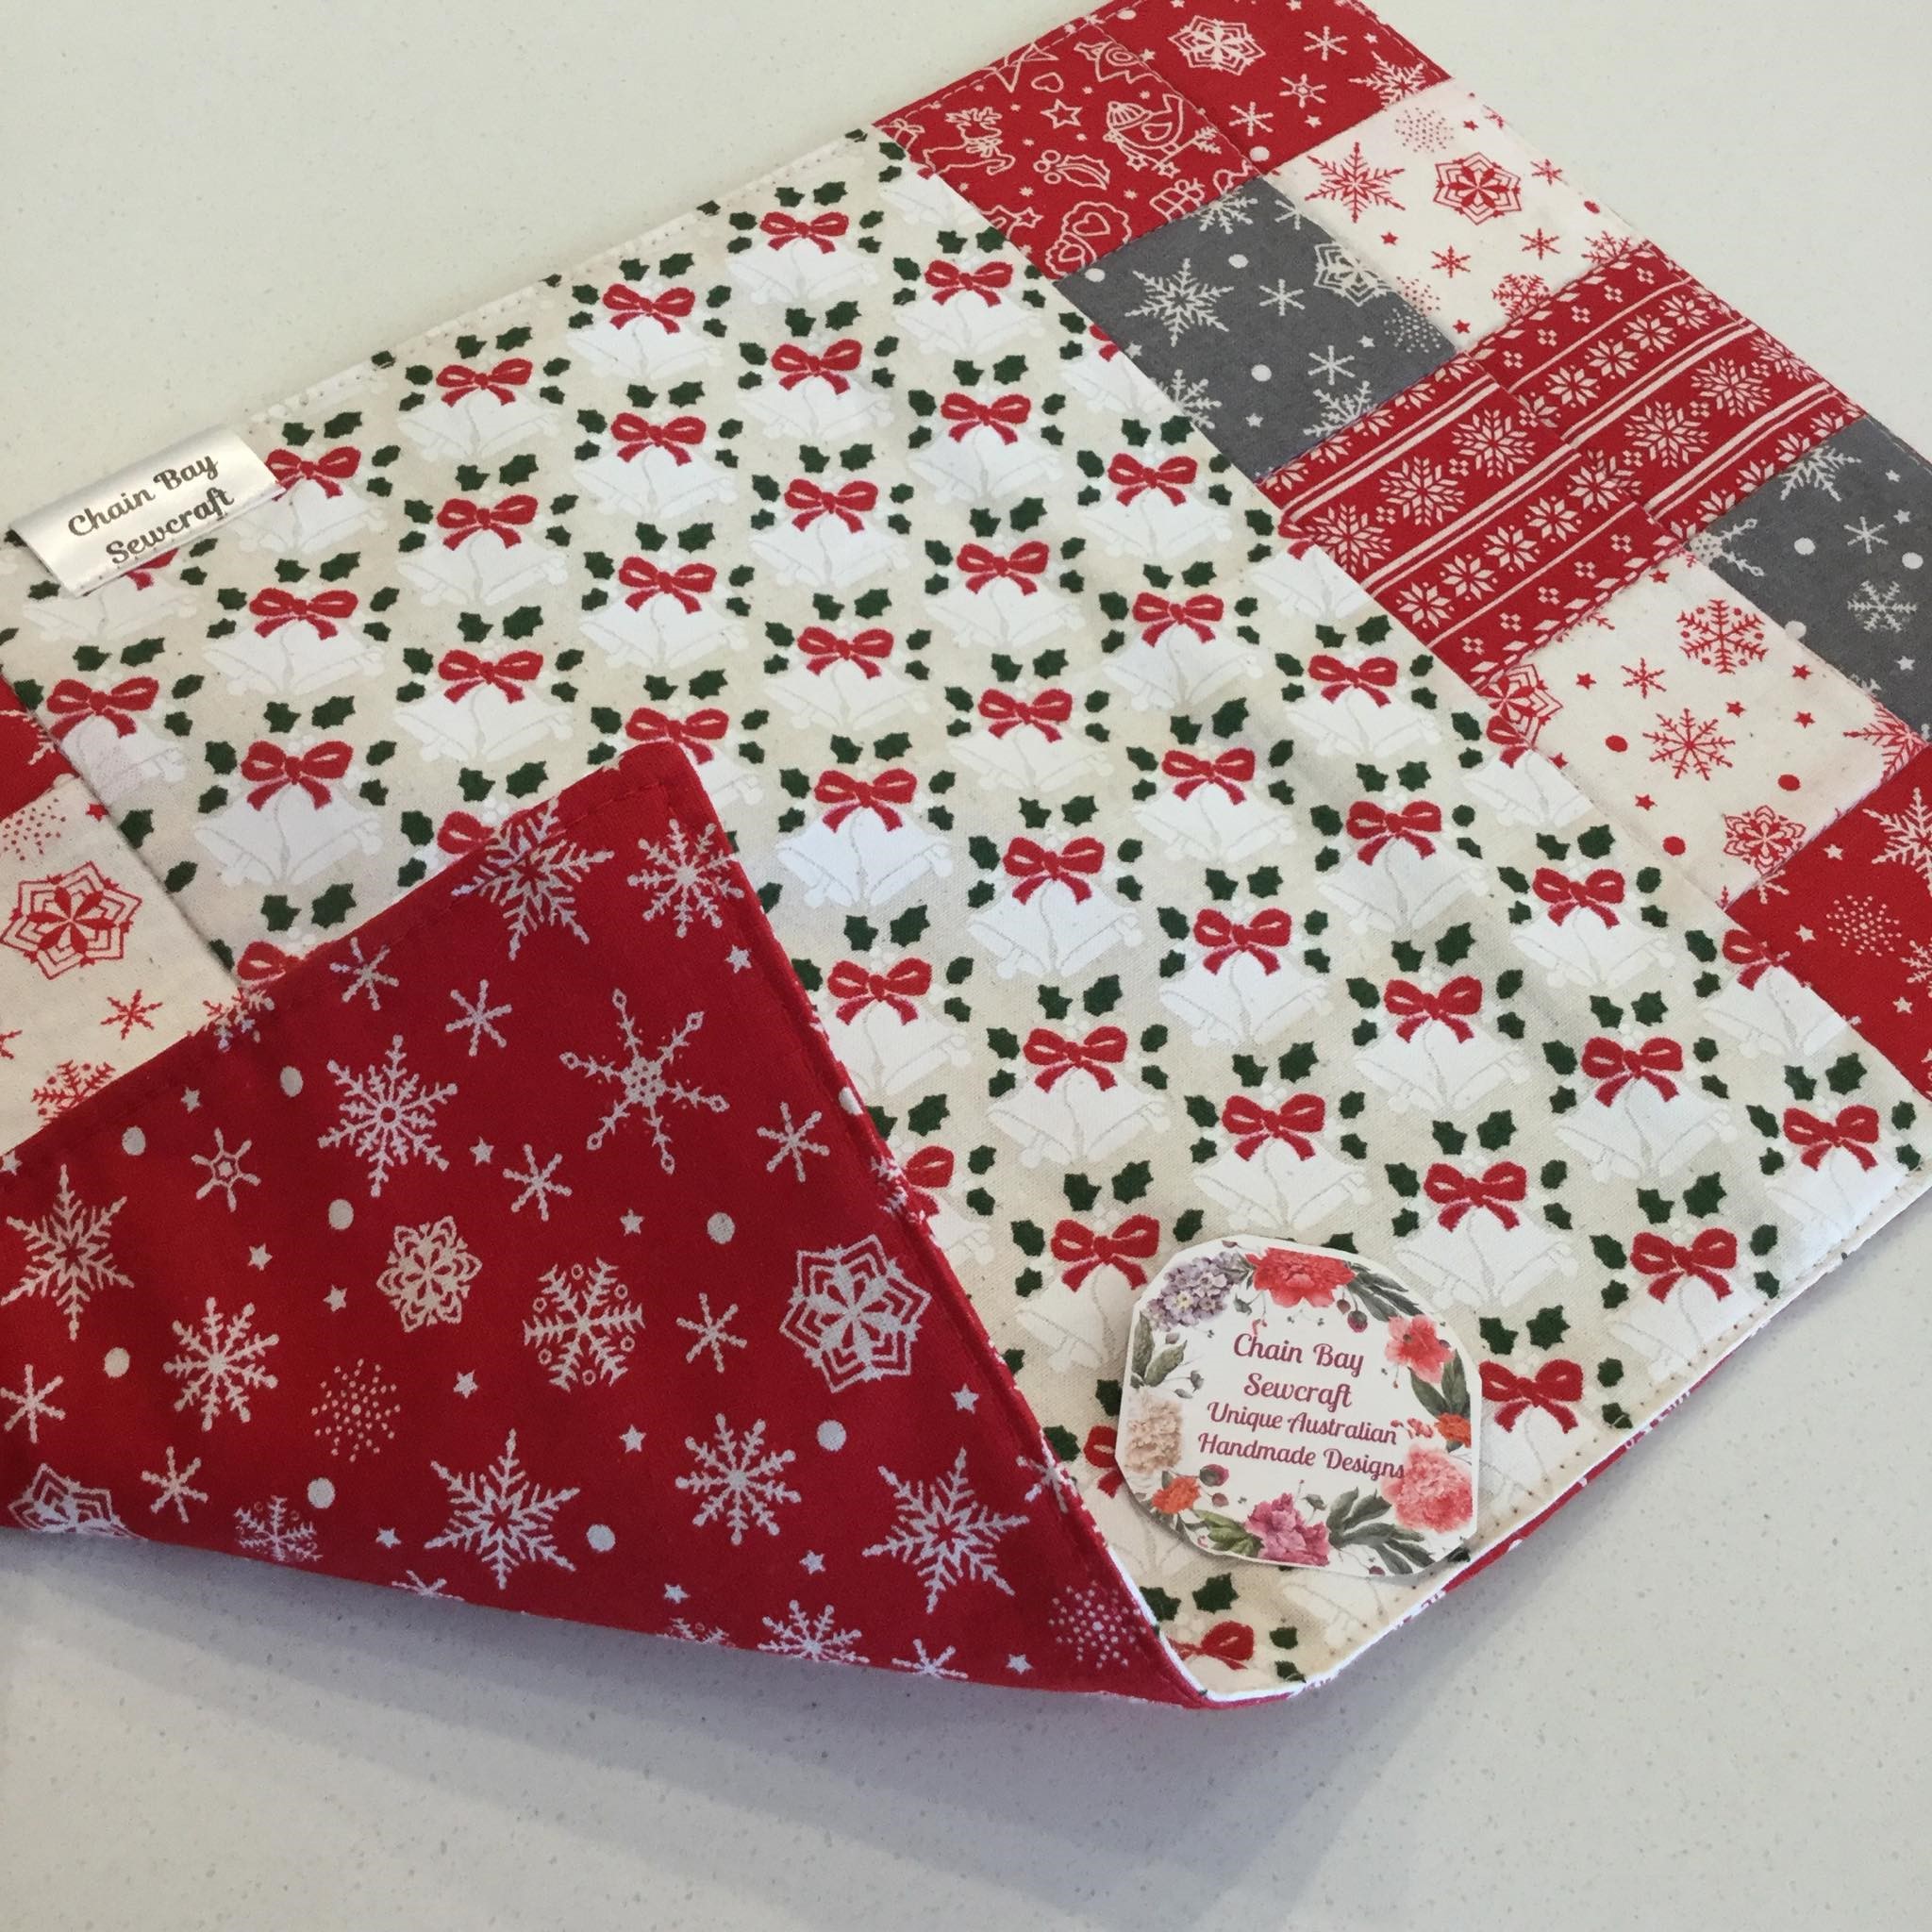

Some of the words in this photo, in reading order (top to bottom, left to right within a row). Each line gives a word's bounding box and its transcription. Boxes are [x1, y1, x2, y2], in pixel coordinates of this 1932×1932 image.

[68, 486, 156, 536] Chain
[153, 456, 218, 491] Bay
[106, 487, 234, 565] Sewcraft
[1233, 1333, 1303, 1364] Chain
[1313, 1343, 1364, 1377] Bay
[1243, 1373, 1352, 1412] Sewcraft
[1208, 1402, 1283, 1432] Unique
[1288, 1412, 1397, 1445] Australian
[1198, 1432, 1316, 1466] Handmade
[1323, 1447, 1405, 1481] Designs
